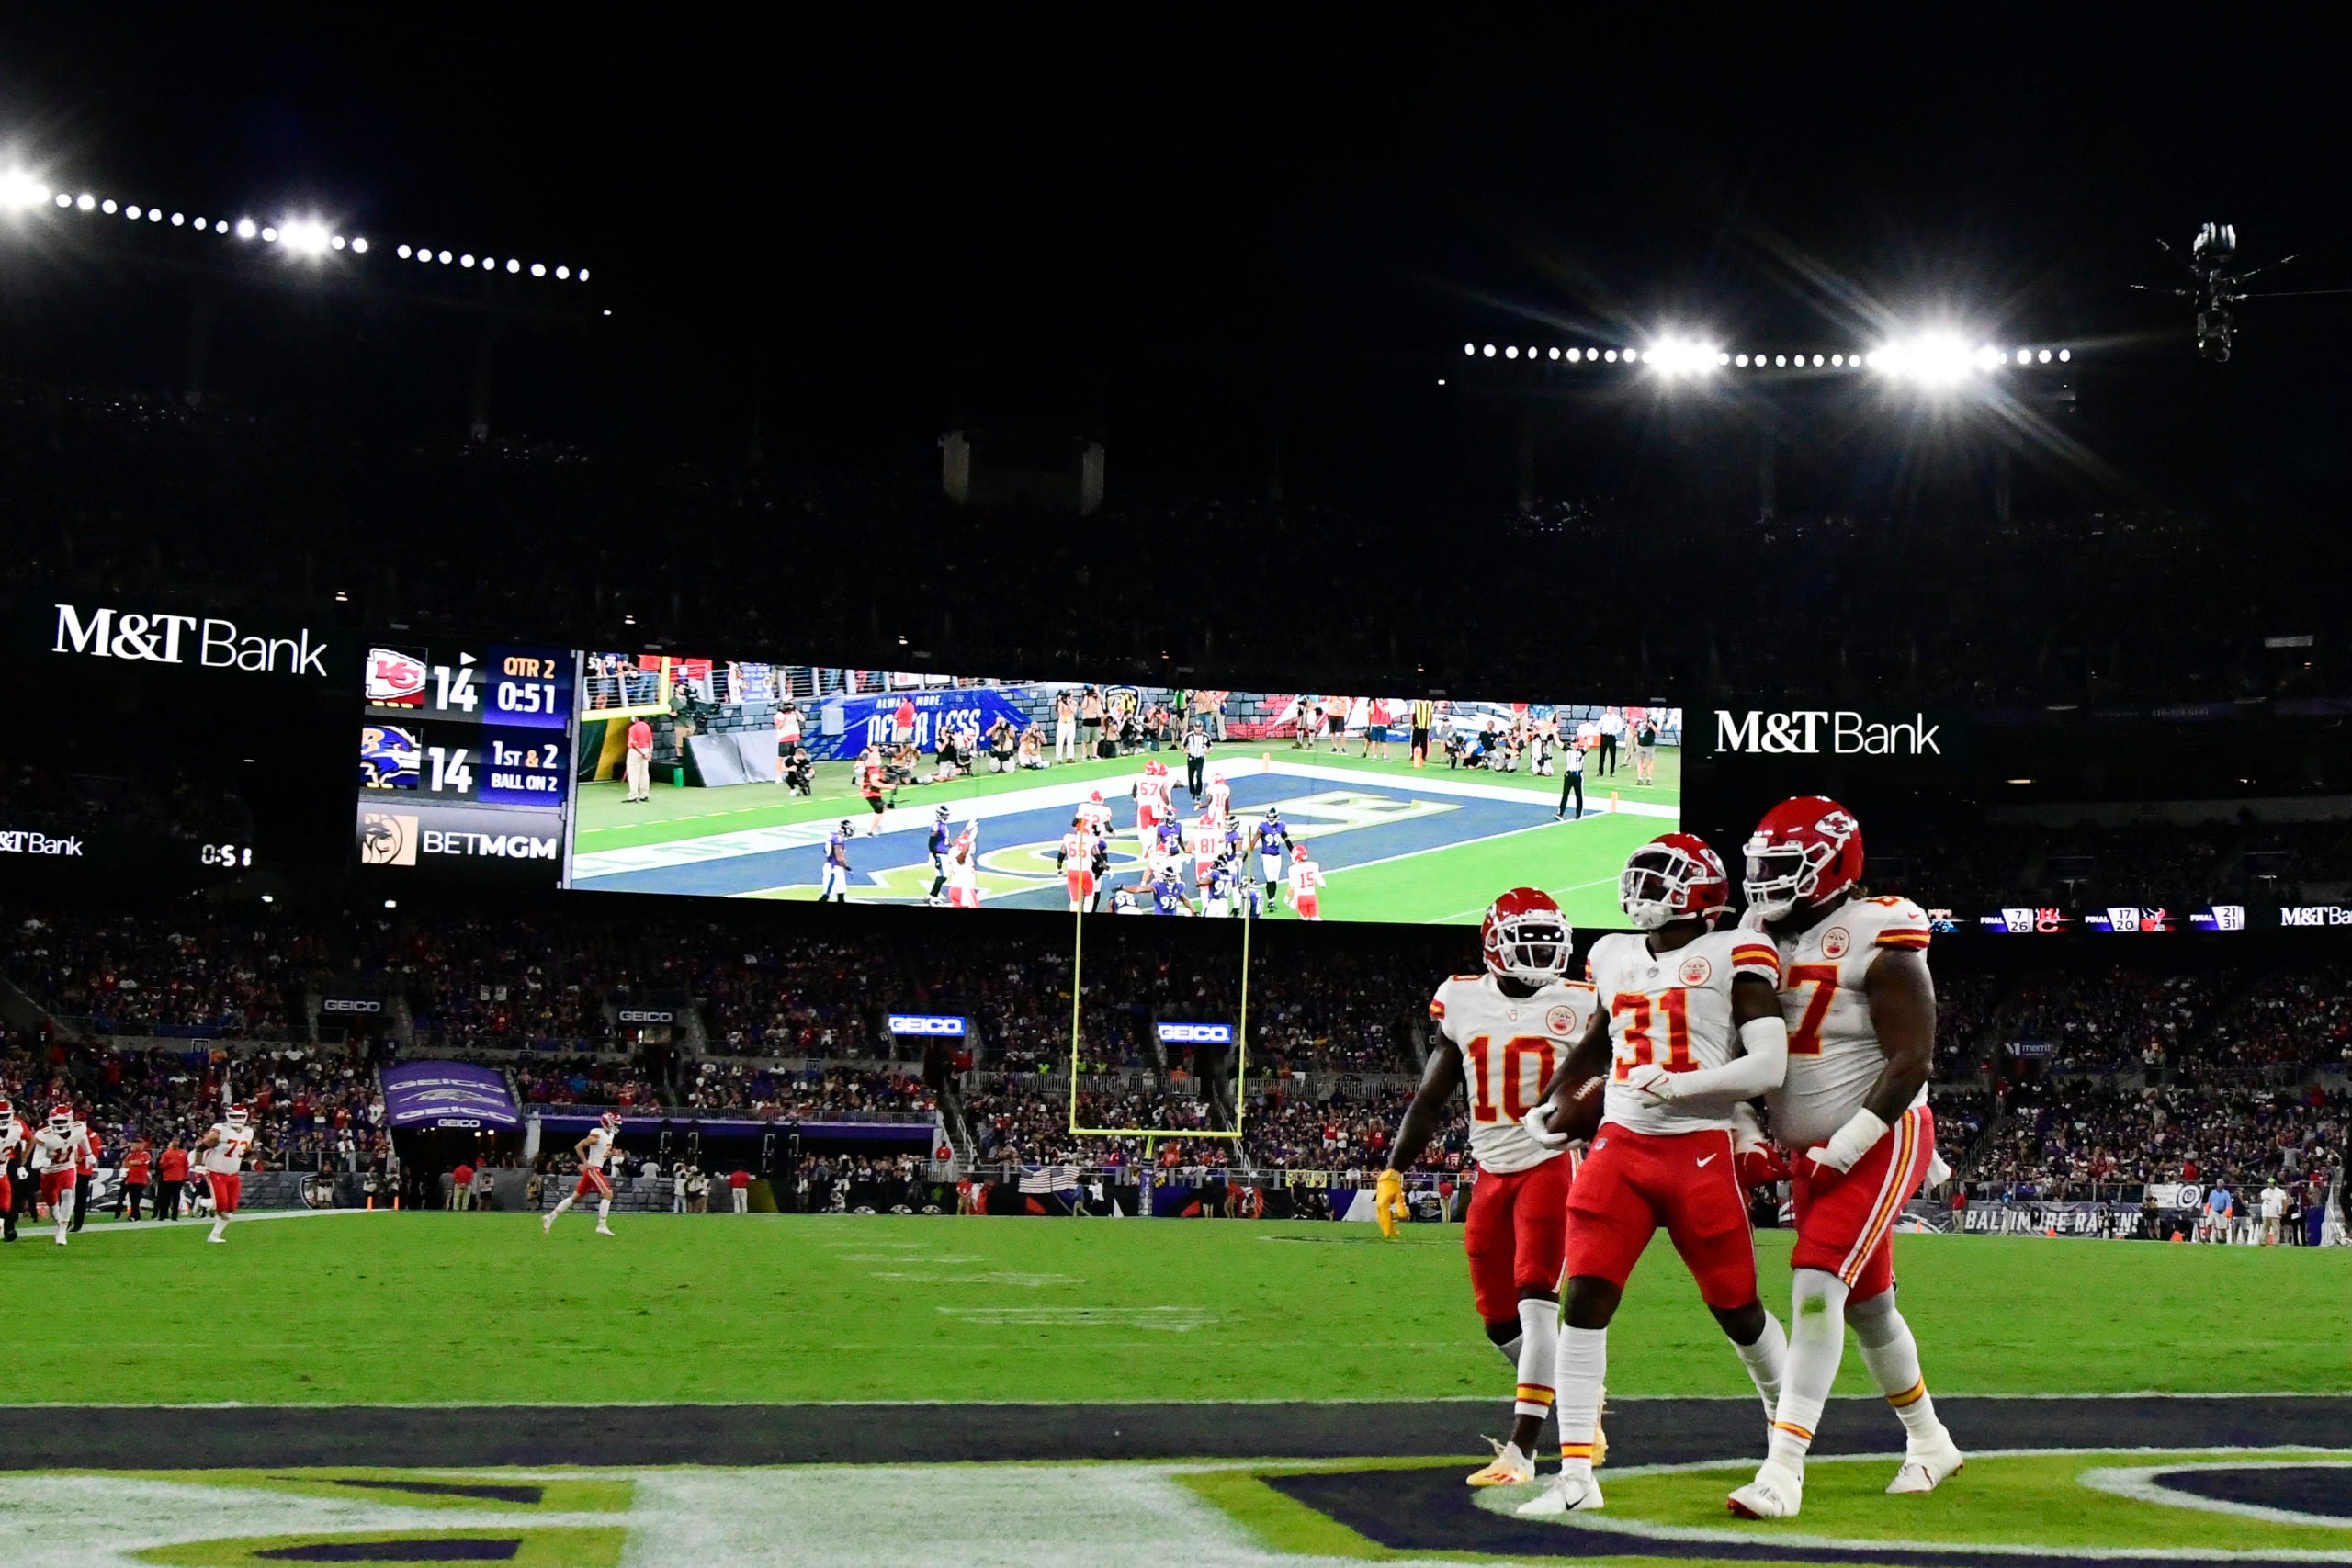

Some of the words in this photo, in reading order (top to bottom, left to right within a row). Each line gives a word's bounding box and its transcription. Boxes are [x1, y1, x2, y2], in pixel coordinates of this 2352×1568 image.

[51, 604, 197, 663] M&T
[200, 618, 328, 677] Bank
[503, 656, 539, 678] QTR
[543, 659, 556, 679] 2
[434, 665, 479, 713] 14
[497, 681, 556, 715] 0:51
[867, 711, 929, 748] NER
[1713, 710, 1829, 753] M&T
[1834, 711, 1941, 755] Bank
[492, 740, 523, 766] 1ST
[525, 750, 540, 768] &
[543, 744, 559, 769] 2
[428, 746, 473, 794] 14
[491, 773, 526, 790] BALL
[526, 775, 546, 791] ON
[548, 776, 559, 792] 2
[0, 830, 28, 853] &T
[28, 832, 84, 857] Bank
[423, 830, 558, 860] BETMGM
[1200, 838, 1215, 854] 81
[1300, 871, 1315, 889] 15
[1980, 916, 2005, 925] FINAL
[2014, 910, 2022, 919] 7
[2085, 915, 2109, 924] FINAL
[2120, 909, 2131, 919] 17
[2190, 913, 2215, 922] FINAL
[2223, 908, 2236, 917] 21
[2280, 907, 2329, 926] M&T
[2329, 906, 2352, 926] Ba
[2009, 921, 2029, 931] 26
[2116, 920, 2134, 931] 20
[2223, 919, 2236, 929] 31
[324, 999, 381, 1011] GEICO
[1787, 963, 1840, 1056] 7
[619, 1010, 673, 1022] GEICO
[888, 1017, 962, 1033] GEICO
[1158, 1024, 1228, 1042] GEICO
[1611, 987, 1701, 1084] 31
[388, 1078, 506, 1094] GEICO
[1467, 1034, 1555, 1125] 10
[395, 1106, 517, 1123] GEICO
[437, 1118, 481, 1128] GEICO
[223, 1139, 253, 1159] 73
[1964, 1209, 2069, 1233] BALIMRE
[2075, 1211, 2143, 1233] RAENS
